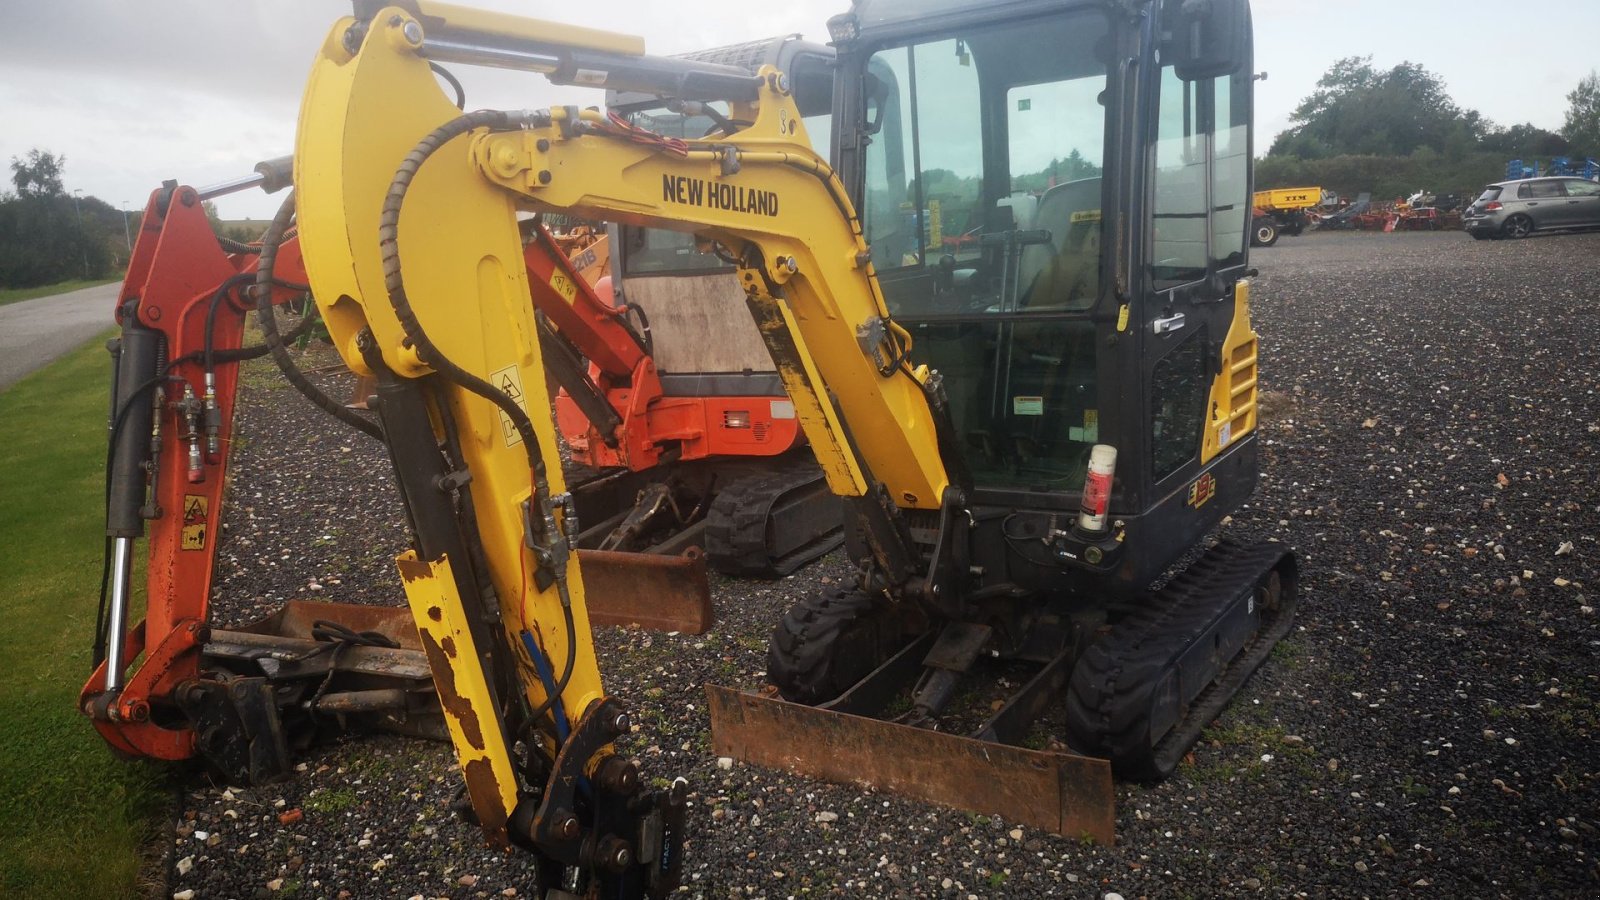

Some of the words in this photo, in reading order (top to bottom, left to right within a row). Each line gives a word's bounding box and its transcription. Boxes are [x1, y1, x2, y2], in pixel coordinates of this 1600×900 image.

[662, 173, 704, 207] NEW
[707, 181, 779, 217] HOLLAND
[1285, 194, 1308, 202] TIM
